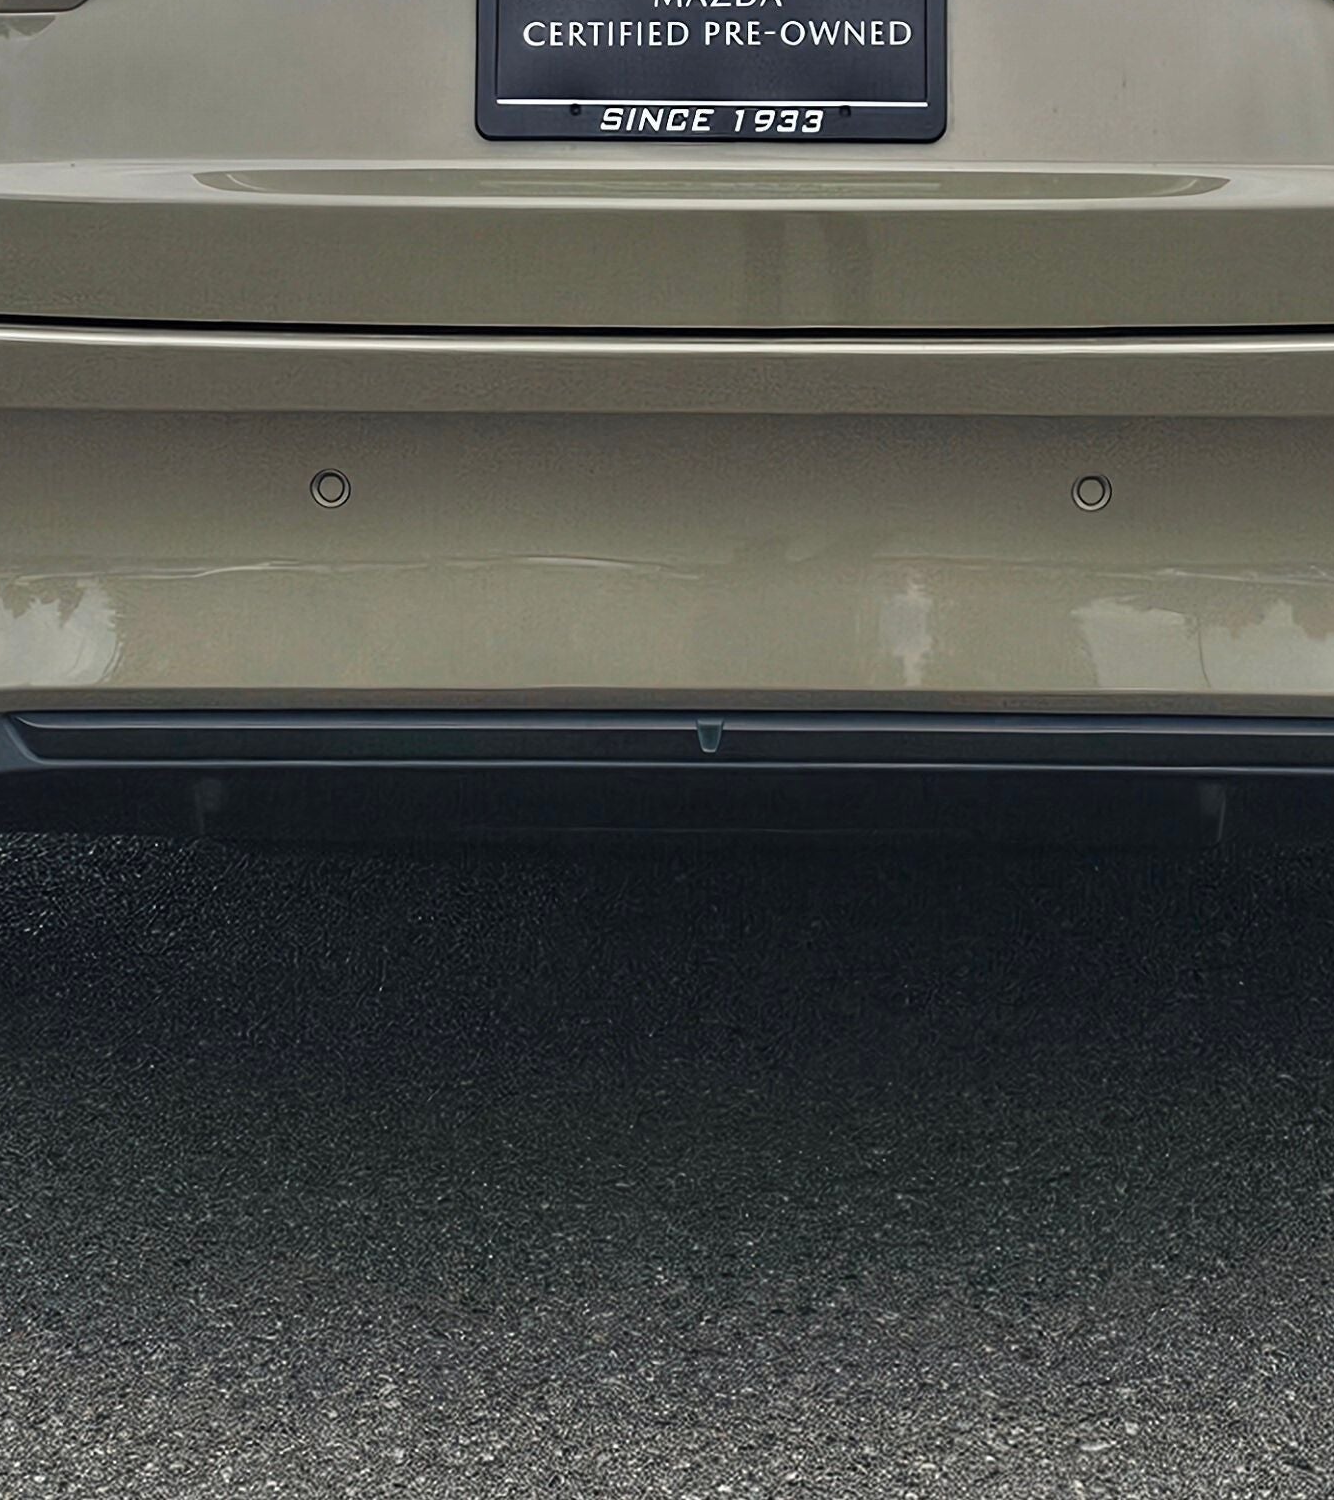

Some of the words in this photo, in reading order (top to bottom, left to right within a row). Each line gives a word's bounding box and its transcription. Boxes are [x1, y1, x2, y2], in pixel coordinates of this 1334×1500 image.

[523, 20, 689, 47] CERTIFIED
[704, 20, 913, 47] PRE-OWNED
[600, 107, 715, 133] SINCE
[733, 108, 825, 134] 1933
